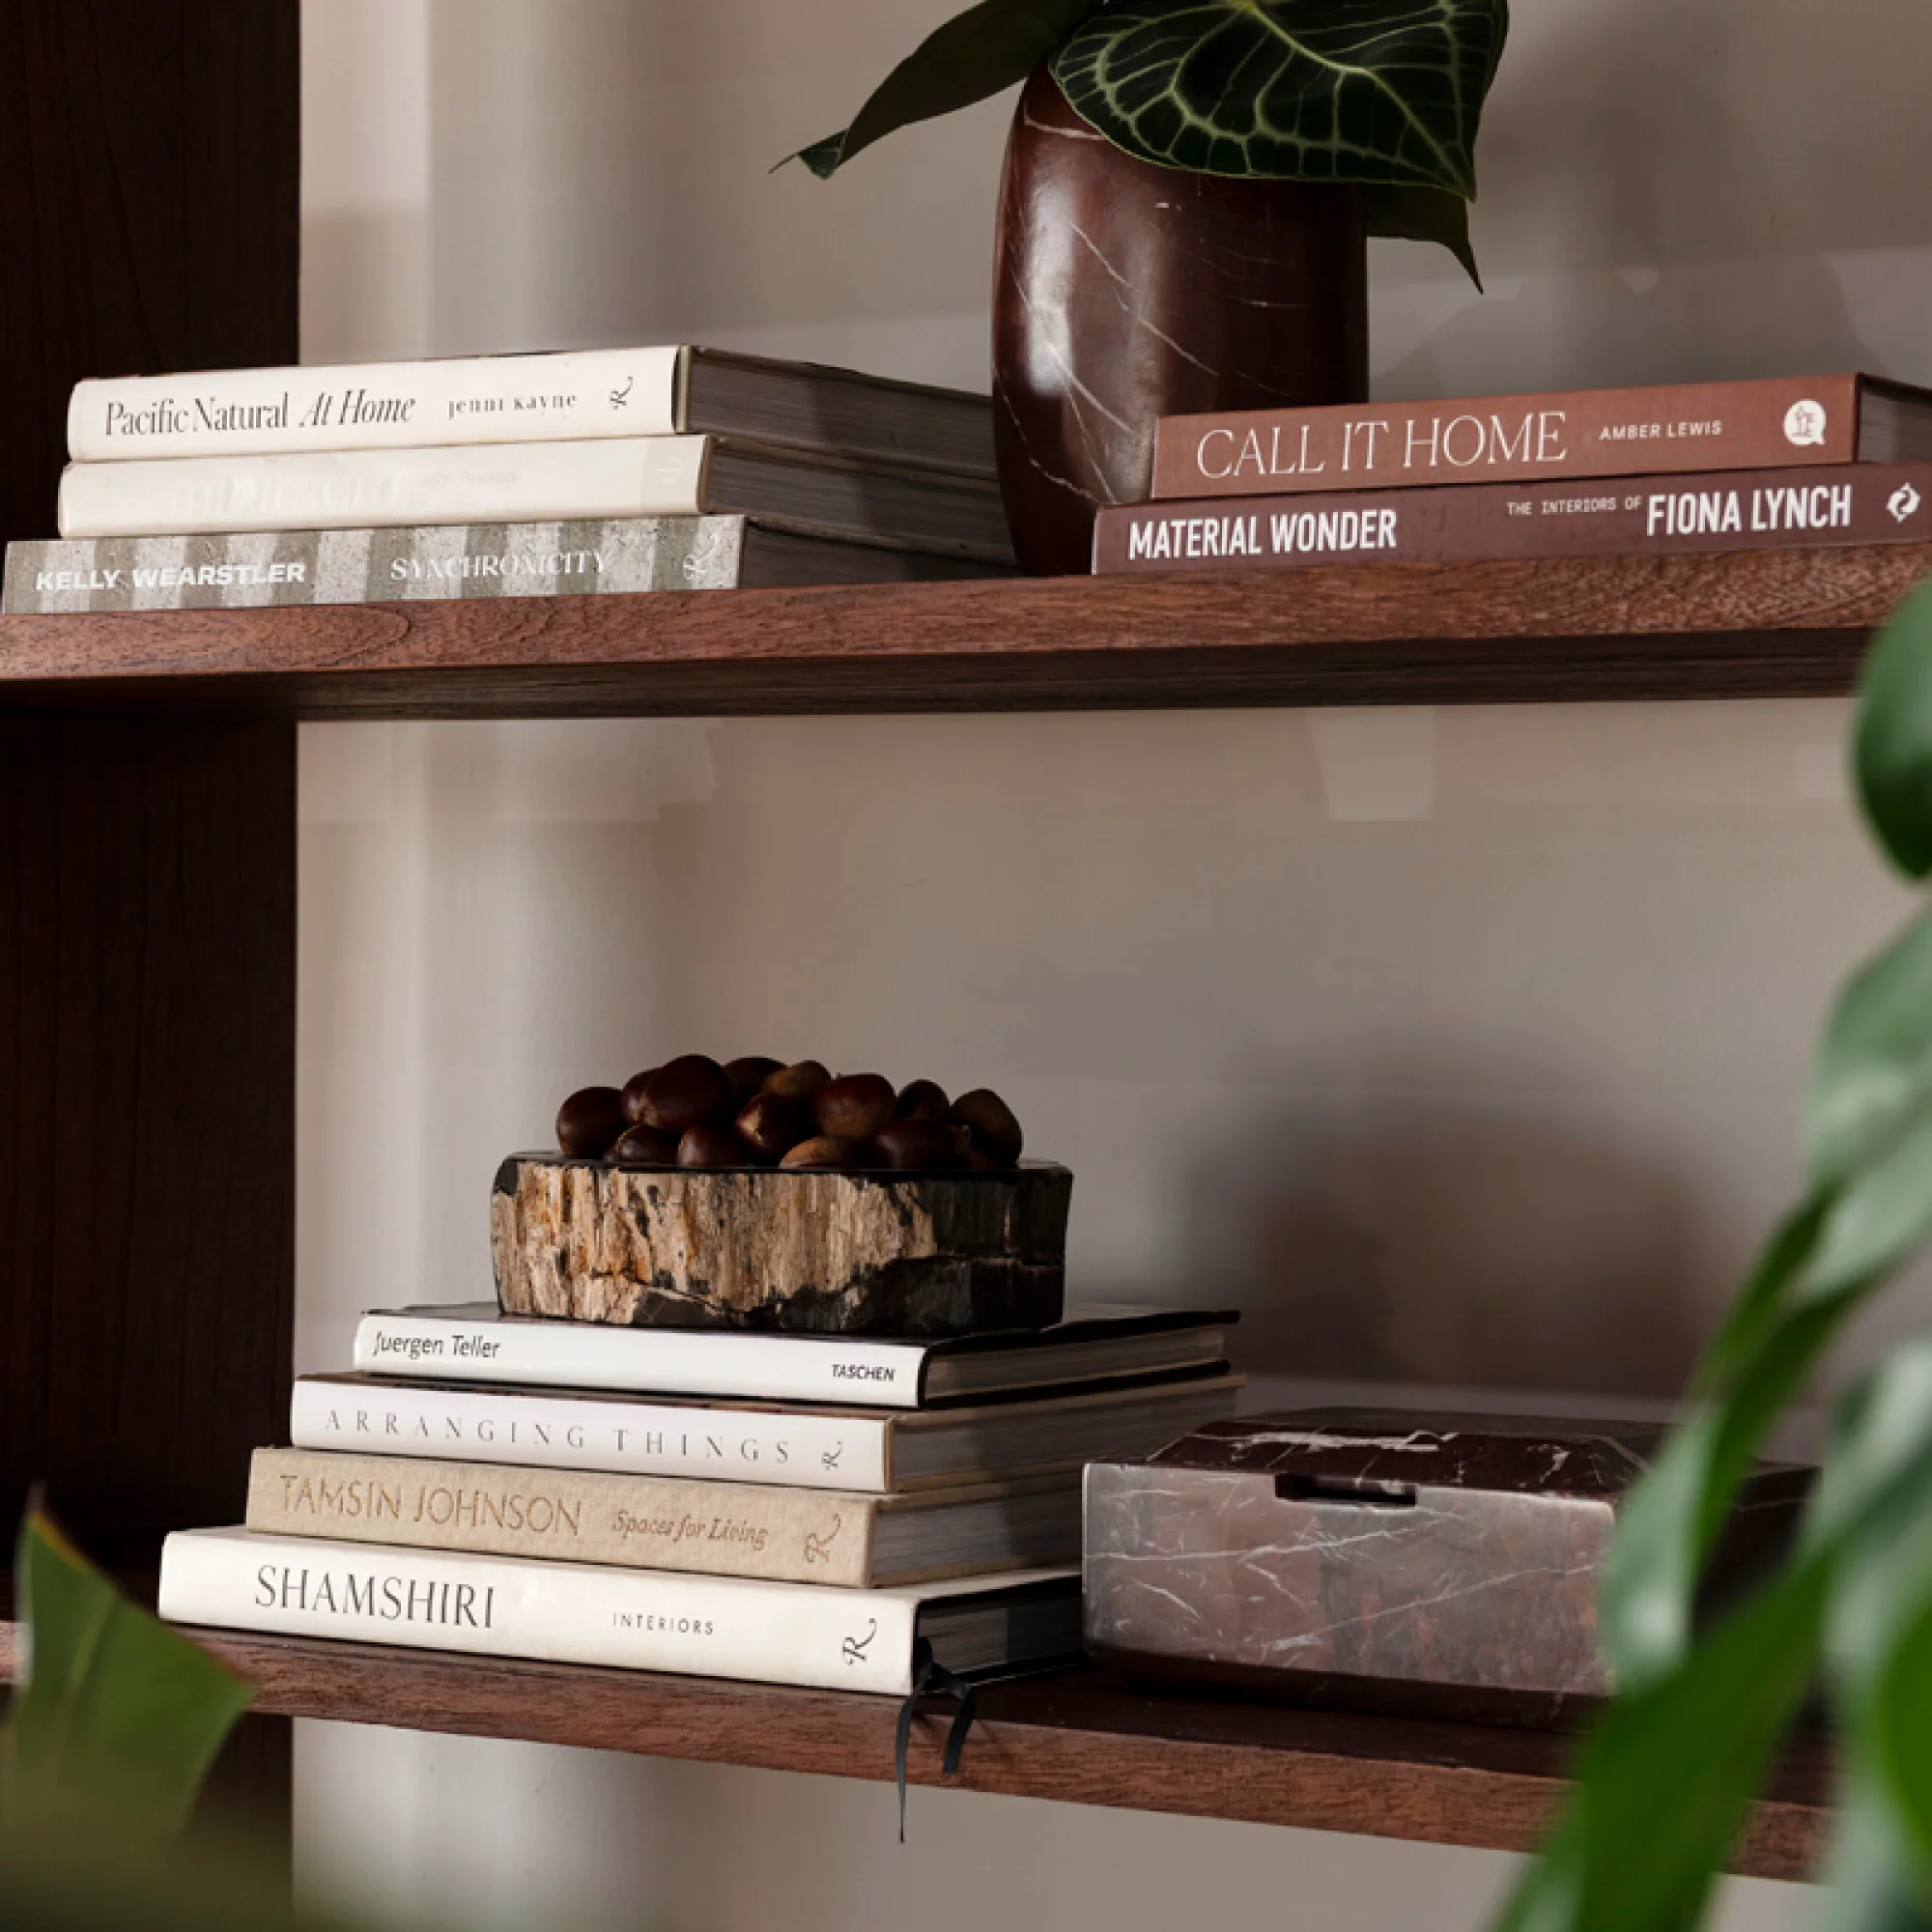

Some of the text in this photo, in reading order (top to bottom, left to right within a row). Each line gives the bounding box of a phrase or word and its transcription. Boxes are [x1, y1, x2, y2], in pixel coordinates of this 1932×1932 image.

[105, 387, 416, 436] Pacific Natural At Home
[1598, 419, 1723, 441] AMBER LEWIS
[1197, 409, 1569, 479] CALL IT HOME
[1506, 484, 1853, 537] THE INTERIORS OF FIONA LYNCH
[1128, 508, 1398, 561] MATERIAL WONDER
[36, 562, 306, 591] KELLY WEARSTLER
[390, 548, 606, 581] SYNCHRONICITY
[371, 1330, 501, 1361] Juergen Teller
[831, 1362, 896, 1382] TASCHEN
[325, 1408, 789, 1465] ARRANGING THINGS
[279, 1473, 582, 1538] TAMSIN JOHNSON
[612, 1508, 769, 1552] Spaces for Living
[255, 1563, 496, 1630] SHAMSHIRI
[612, 1611, 715, 1636] INTERIORS
